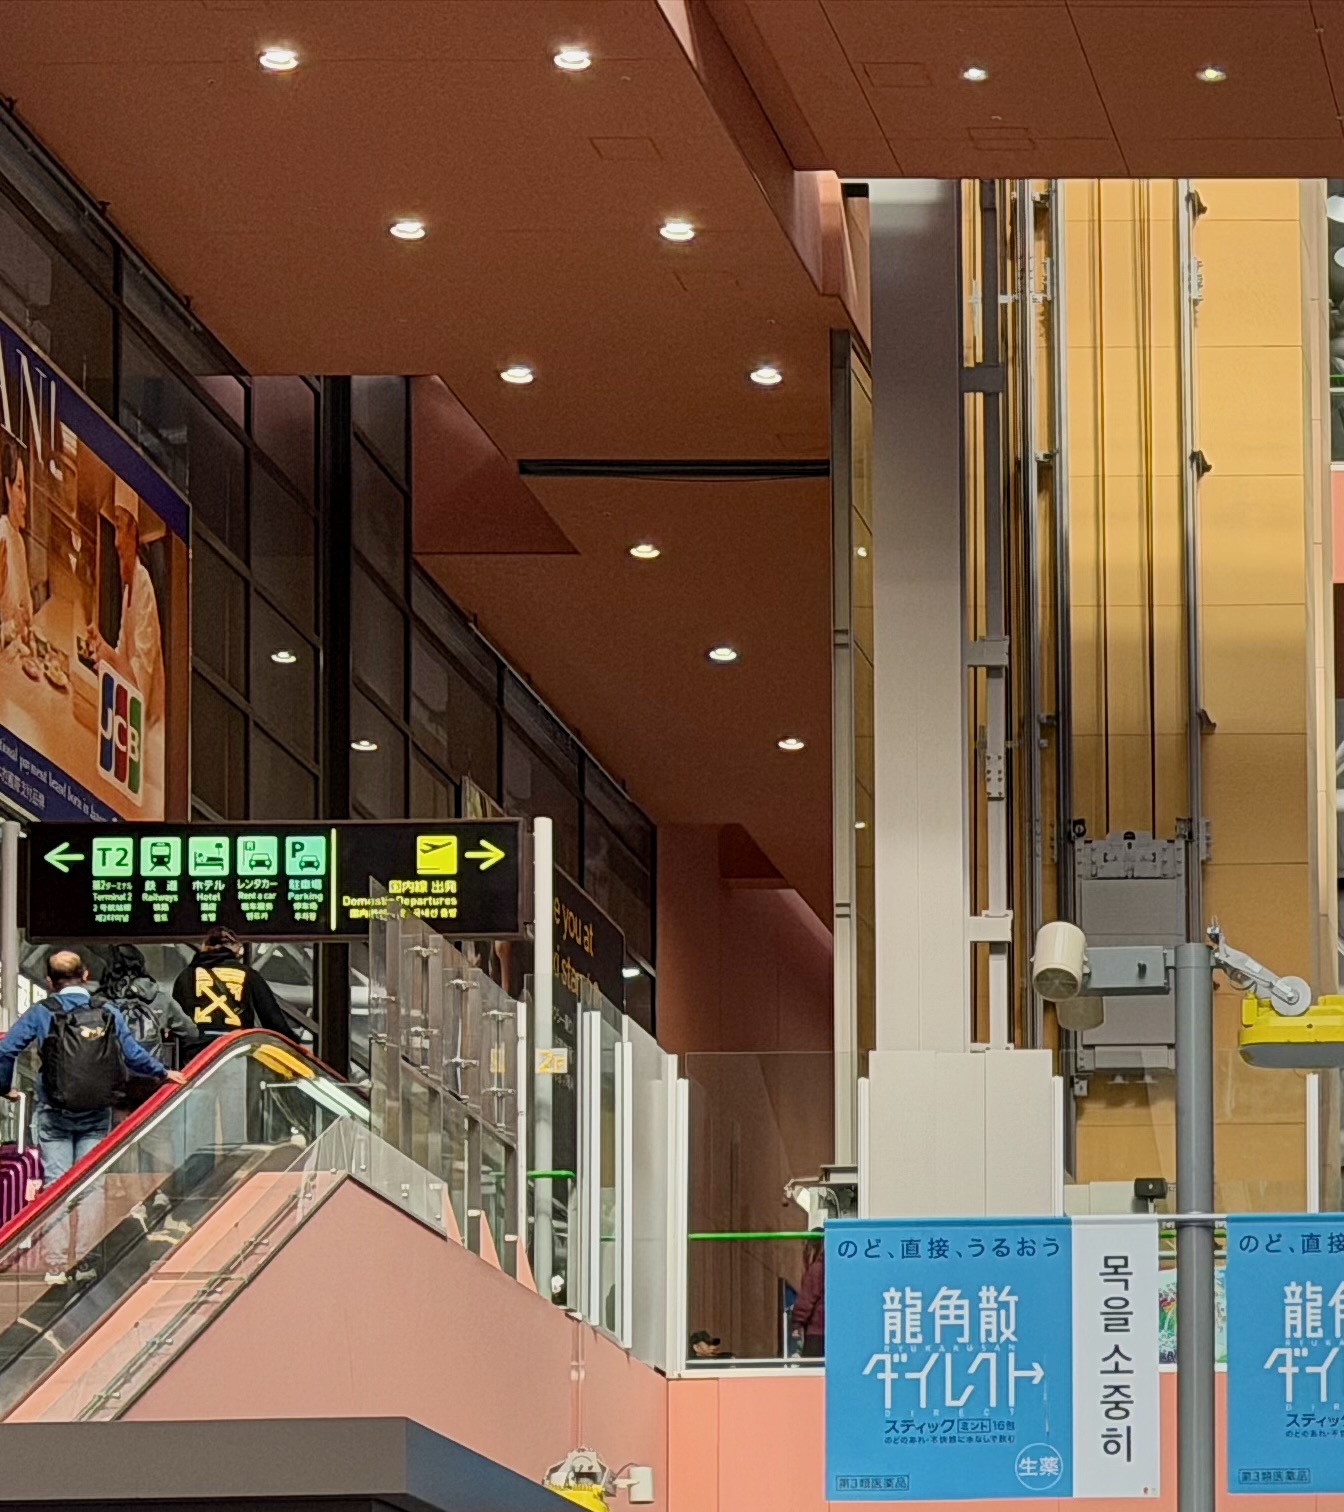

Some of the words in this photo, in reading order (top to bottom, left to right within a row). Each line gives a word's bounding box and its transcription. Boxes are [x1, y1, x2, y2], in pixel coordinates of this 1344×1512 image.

[101, 709, 140, 763] JCB
[97, 847, 129, 868] T2
[192, 880, 225, 891] ホテル
[237, 879, 278, 890] レンタカー
[92, 892, 127, 902] Terminal
[128, 892, 133, 901] 2
[142, 892, 178, 903] Railways
[196, 892, 221, 902] Hotel
[287, 892, 323, 903] Parking
[562, 905, 582, 945] you
[584, 921, 594, 957] at
[837, 1237, 1060, 1259] のど、直接、うるおう
[882, 1285, 1018, 1344] 龍角散
[862, 1353, 1045, 1409] ダイレクト
[1099, 1344, 1134, 1462] 소중히
[885, 1408, 1016, 1417] DIRECT
[884, 1419, 955, 1434] スティック
[960, 1421, 989, 1431] ミント
